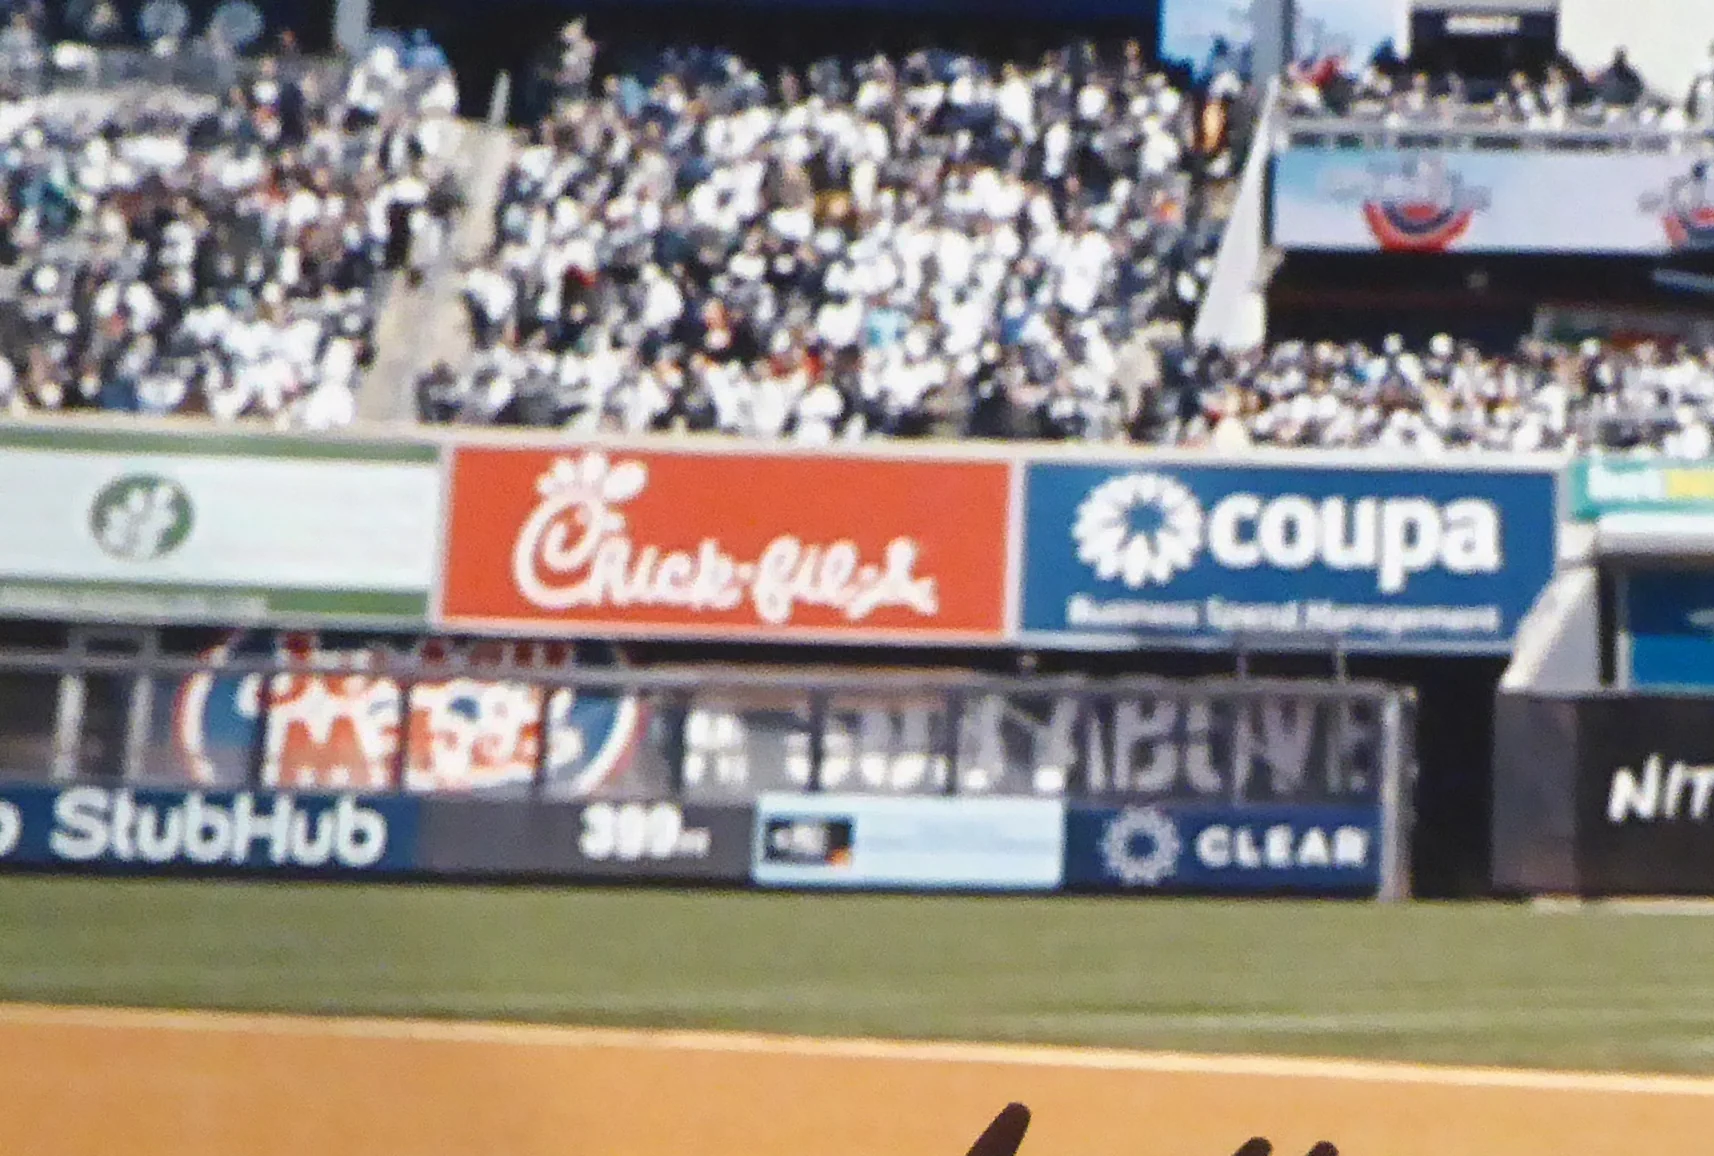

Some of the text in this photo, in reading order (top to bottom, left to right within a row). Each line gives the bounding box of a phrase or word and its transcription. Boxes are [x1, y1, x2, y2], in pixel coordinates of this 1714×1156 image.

[513, 452, 940, 623] Chick-fil-A
[1209, 493, 1503, 594] coupa
[51, 786, 388, 867] StubHub
[1196, 825, 1369, 868] CLEAR
